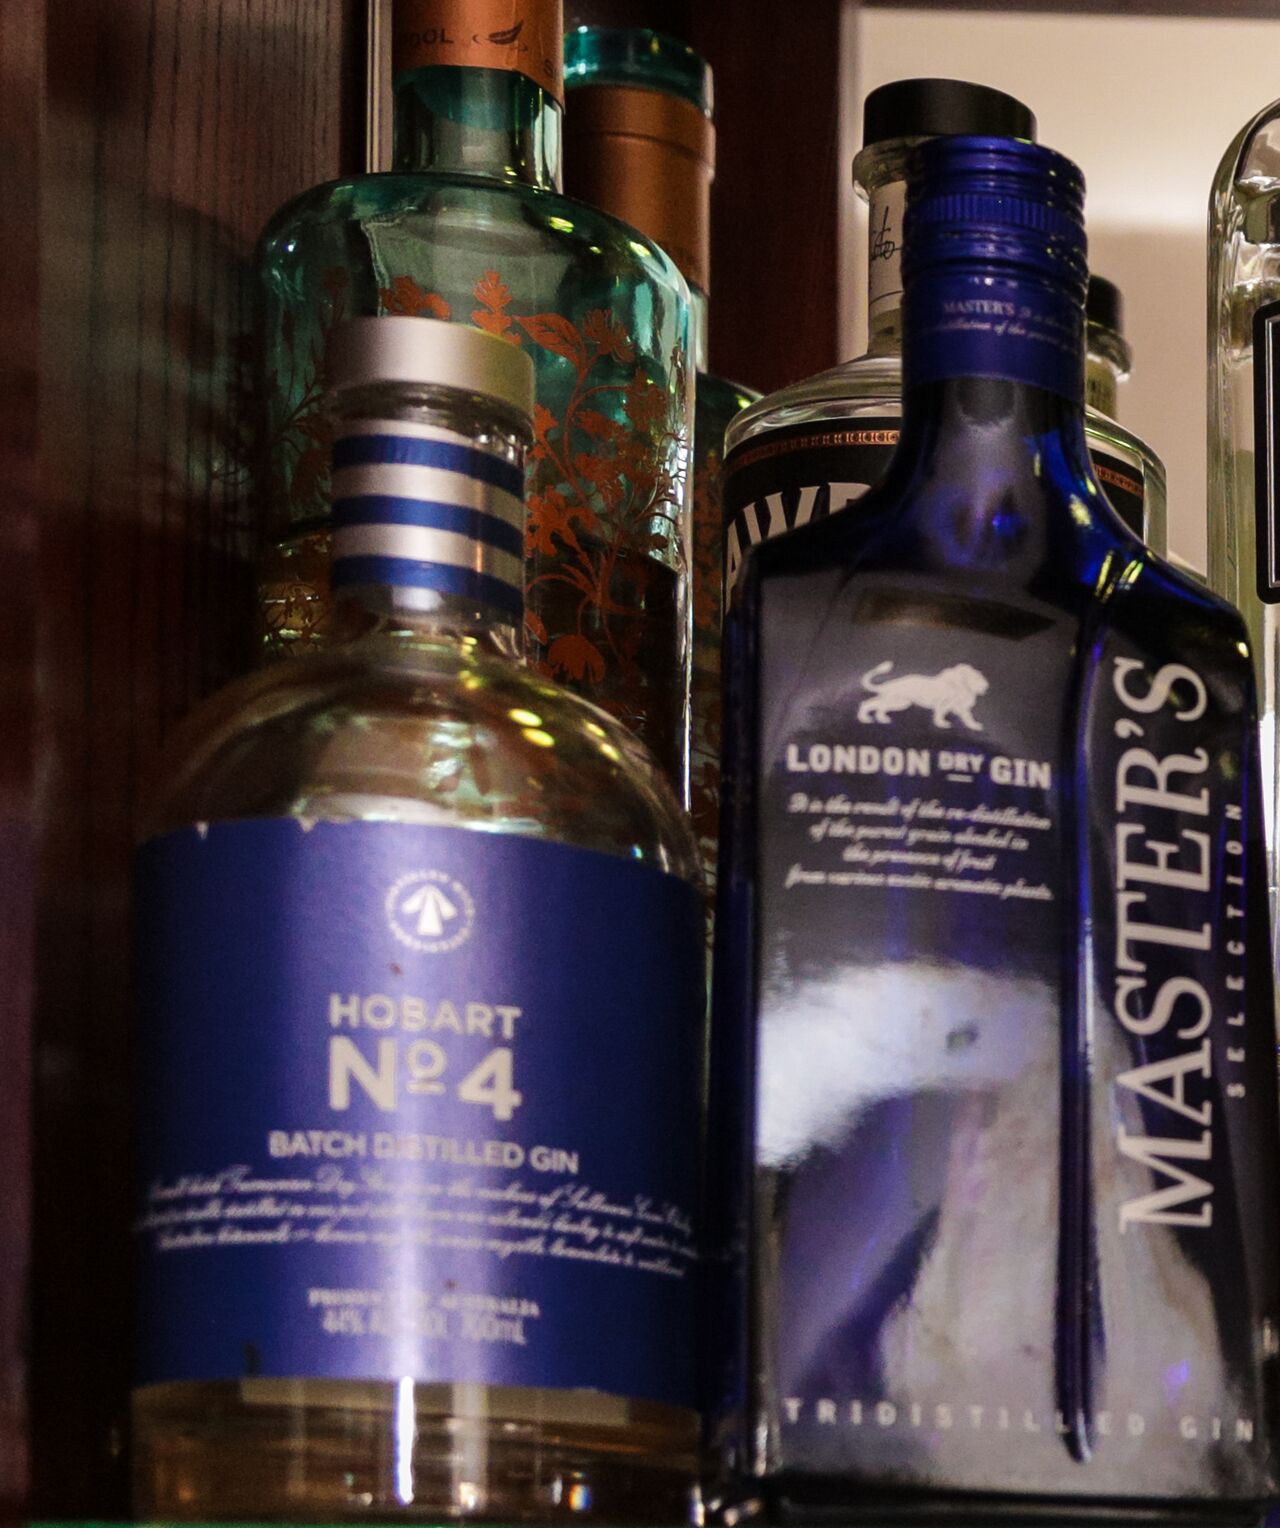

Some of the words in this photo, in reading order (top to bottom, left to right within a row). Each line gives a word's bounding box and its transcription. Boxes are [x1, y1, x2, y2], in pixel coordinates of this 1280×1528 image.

[786, 744, 932, 778] LONDON
[937, 751, 985, 773] DRY
[989, 756, 1052, 790] GIN
[1113, 657, 1214, 1231] MASTER'S
[1226, 803, 1246, 1098] SELECTION
[329, 992, 523, 1040] HOBART
[458, 1047, 523, 1121] 4
[268, 1130, 367, 1158] BATCH
[373, 1131, 525, 1169] DISTILLED
[529, 1146, 579, 1174] GIN
[783, 1398, 1146, 1435] TRIDISTILLED
[1179, 1415, 1254, 1443] GIN
